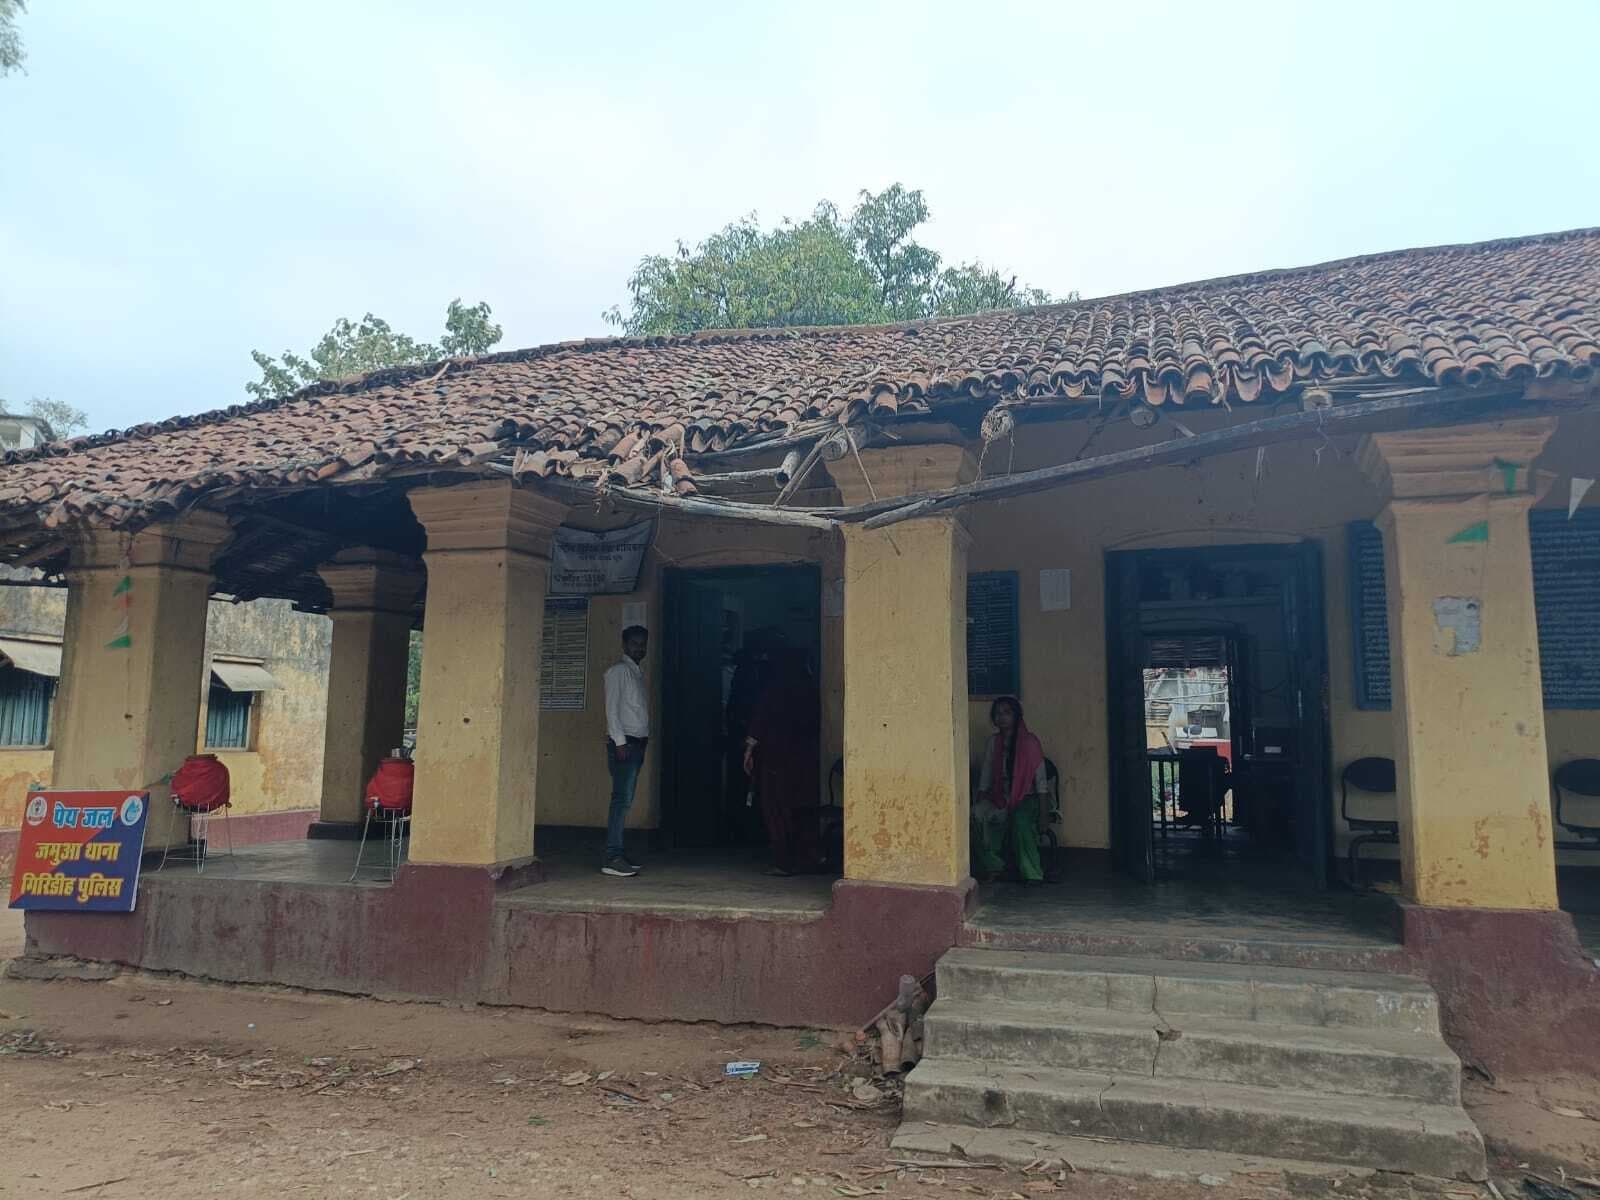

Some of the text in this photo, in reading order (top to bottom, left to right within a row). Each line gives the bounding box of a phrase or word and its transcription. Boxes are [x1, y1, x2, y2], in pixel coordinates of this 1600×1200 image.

[54, 802, 116, 828] पेय जल
[35, 843, 121, 865] जमुआ थाना
[21, 873, 124, 902] गिरिडीह पुलिस
